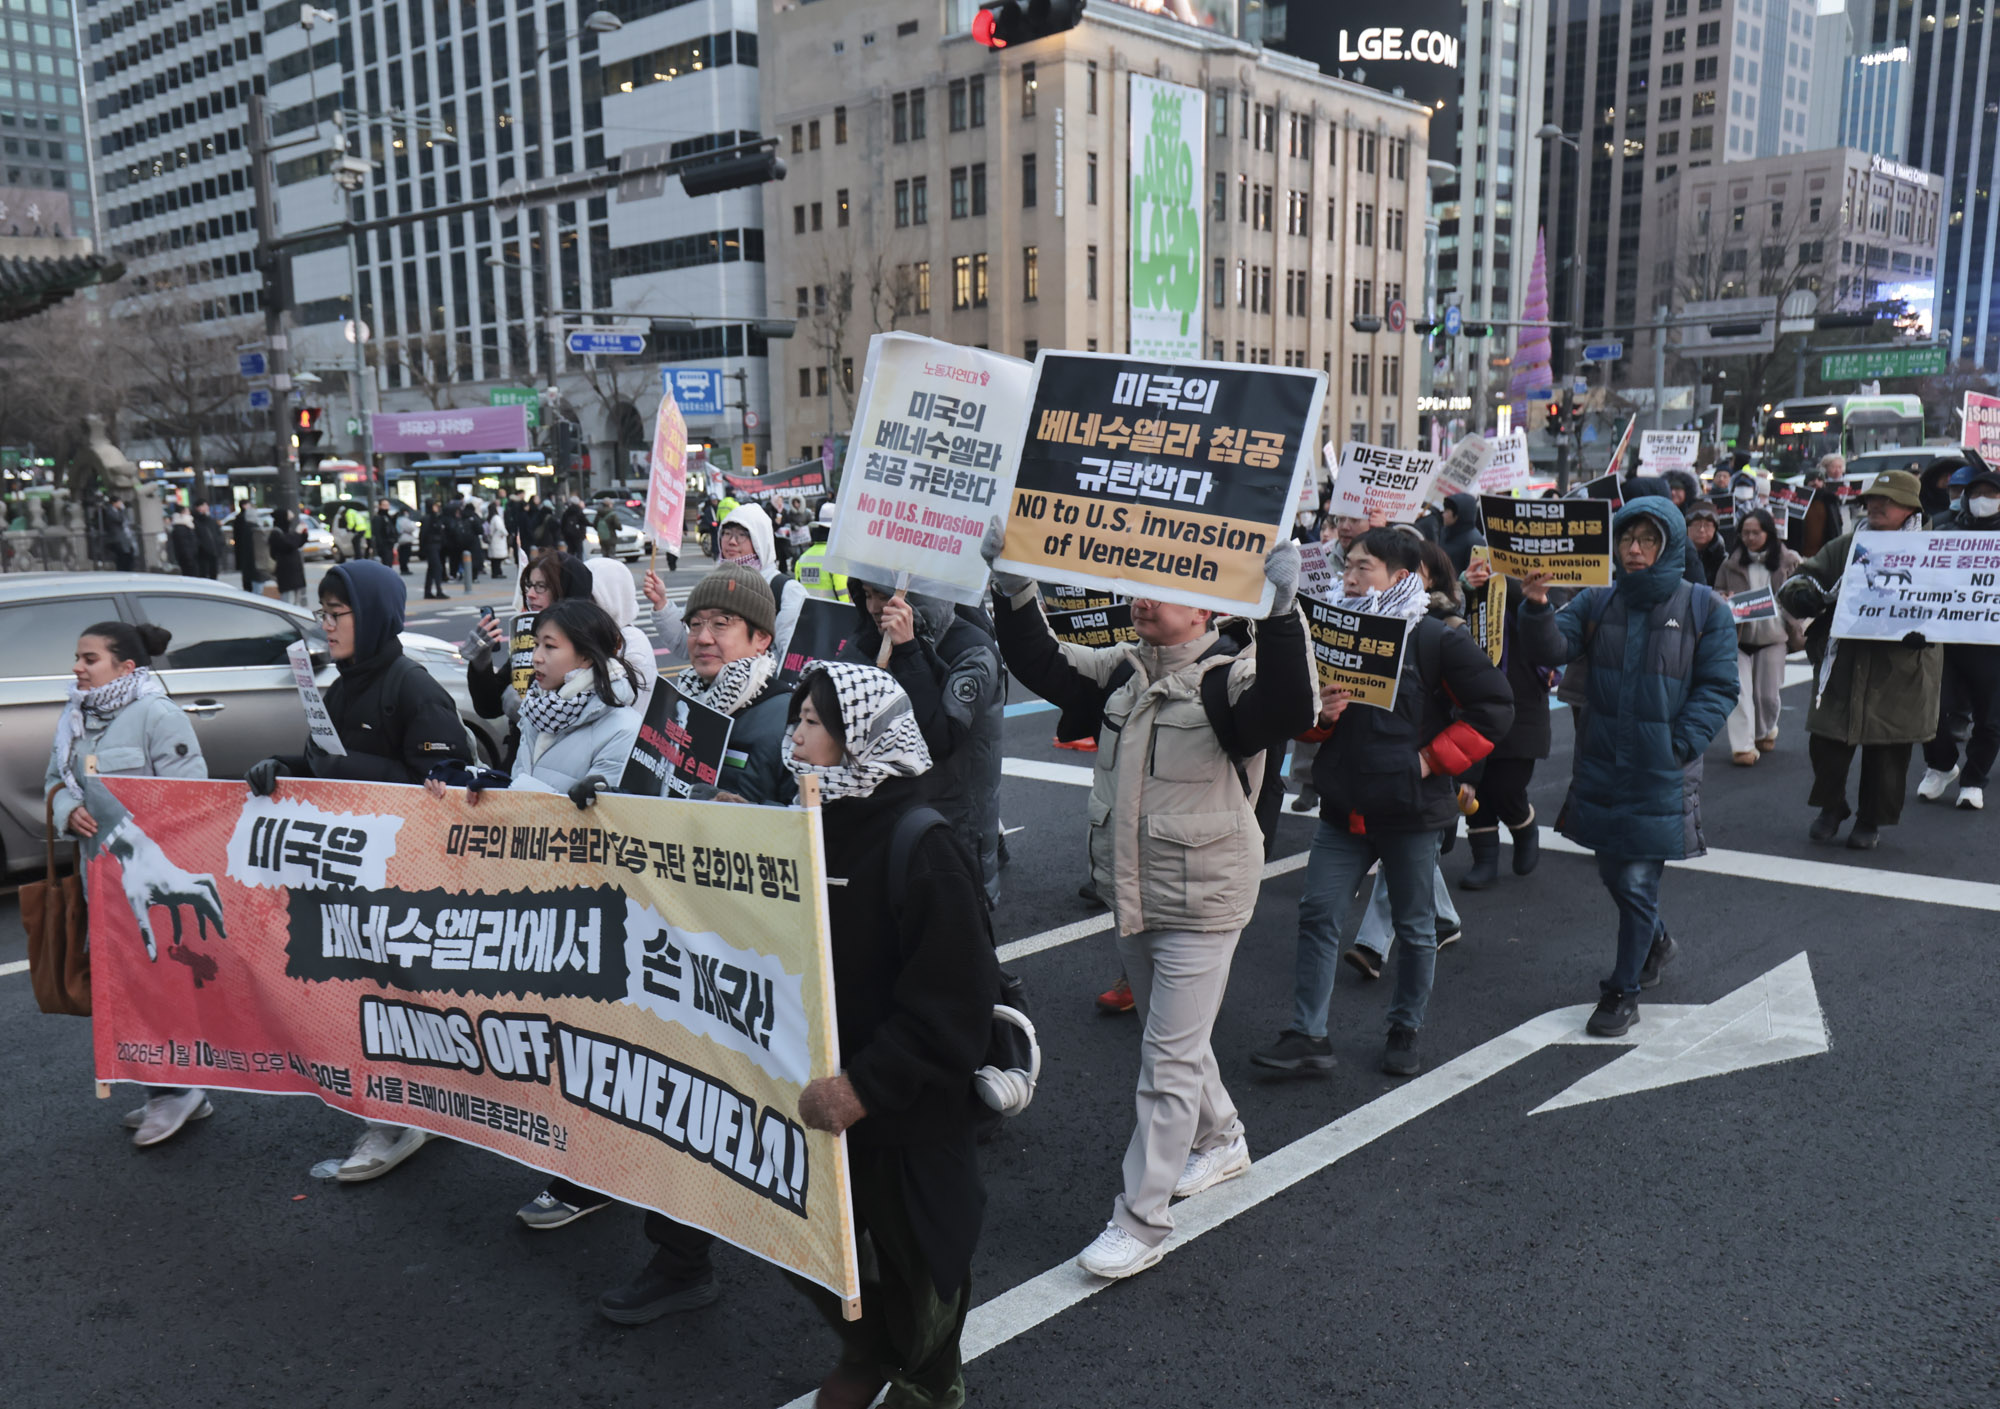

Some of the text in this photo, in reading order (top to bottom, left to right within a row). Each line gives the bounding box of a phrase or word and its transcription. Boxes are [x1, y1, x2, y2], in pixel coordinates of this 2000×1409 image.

[1339, 27, 1458, 69] LGE.COM
[923, 362, 978, 384] 노동자연대
[1112, 372, 1219, 414] 미국의
[907, 391, 986, 432] 미국의
[875, 420, 1002, 472] 베네수엘라
[1037, 409, 1286, 469] 베네수엘라 침공
[1353, 447, 1434, 475] 마두로 납치
[864, 452, 907, 488] 침공
[909, 461, 996, 506] 규탄한다
[1076, 456, 1213, 505] 규탄한다
[1359, 467, 1418, 491] 규탄한다
[1365, 486, 1406, 500] Condemn
[857, 492, 984, 537] No to U.S. invasion
[1343, 491, 1416, 511] the abduction of
[1515, 503, 1564, 519] 미국의
[867, 519, 963, 555] of Venezuela
[1016, 493, 1266, 554] NO to U.S. invasion
[1487, 516, 1602, 536] 베네수엘라 침공
[1044, 533, 1219, 582] of Venezuela
[1493, 550, 1506, 562] NO
[1521, 557, 1544, 568] U.S.
[1549, 557, 1600, 567] invasion
[1510, 537, 1574, 554] 규탄한다
[1883, 554, 1916, 568] 장악
[1920, 555, 1952, 568] 시도
[1308, 571, 1331, 582] NO to
[1971, 573, 1995, 586] NO
[1055, 586, 1086, 597] 미국의
[1899, 589, 1966, 604] Trump's
[1070, 611, 1109, 630] 미국의
[1312, 604, 1360, 632] 미국의
[1859, 604, 1885, 617] for
[1889, 605, 1933, 619] Latin
[1358, 637, 1395, 657] 침공
[1314, 662, 1386, 689] .S. invasion
[631, 746, 656, 772] HANDS
[248, 816, 368, 886] 미국은
[446, 824, 507, 860] 미국의
[511, 826, 611, 865] 베네수엘라
[649, 841, 686, 883] 규탄
[692, 846, 754, 895] 집회와
[757, 854, 801, 902] 행진
[320, 904, 602, 974] 베네수엘라에서
[642, 928, 682, 1002] 손
[117, 1042, 164, 1065] 2026년
[168, 1040, 190, 1066] 1월
[195, 1040, 250, 1072] 10일(토)
[252, 1052, 285, 1073] 오후
[310, 1062, 353, 1098] 30분
[363, 1000, 806, 1209] HANDS OFF VENEZUELA!
[366, 1074, 569, 1152] 서울 르메이에르종로타운 앞
